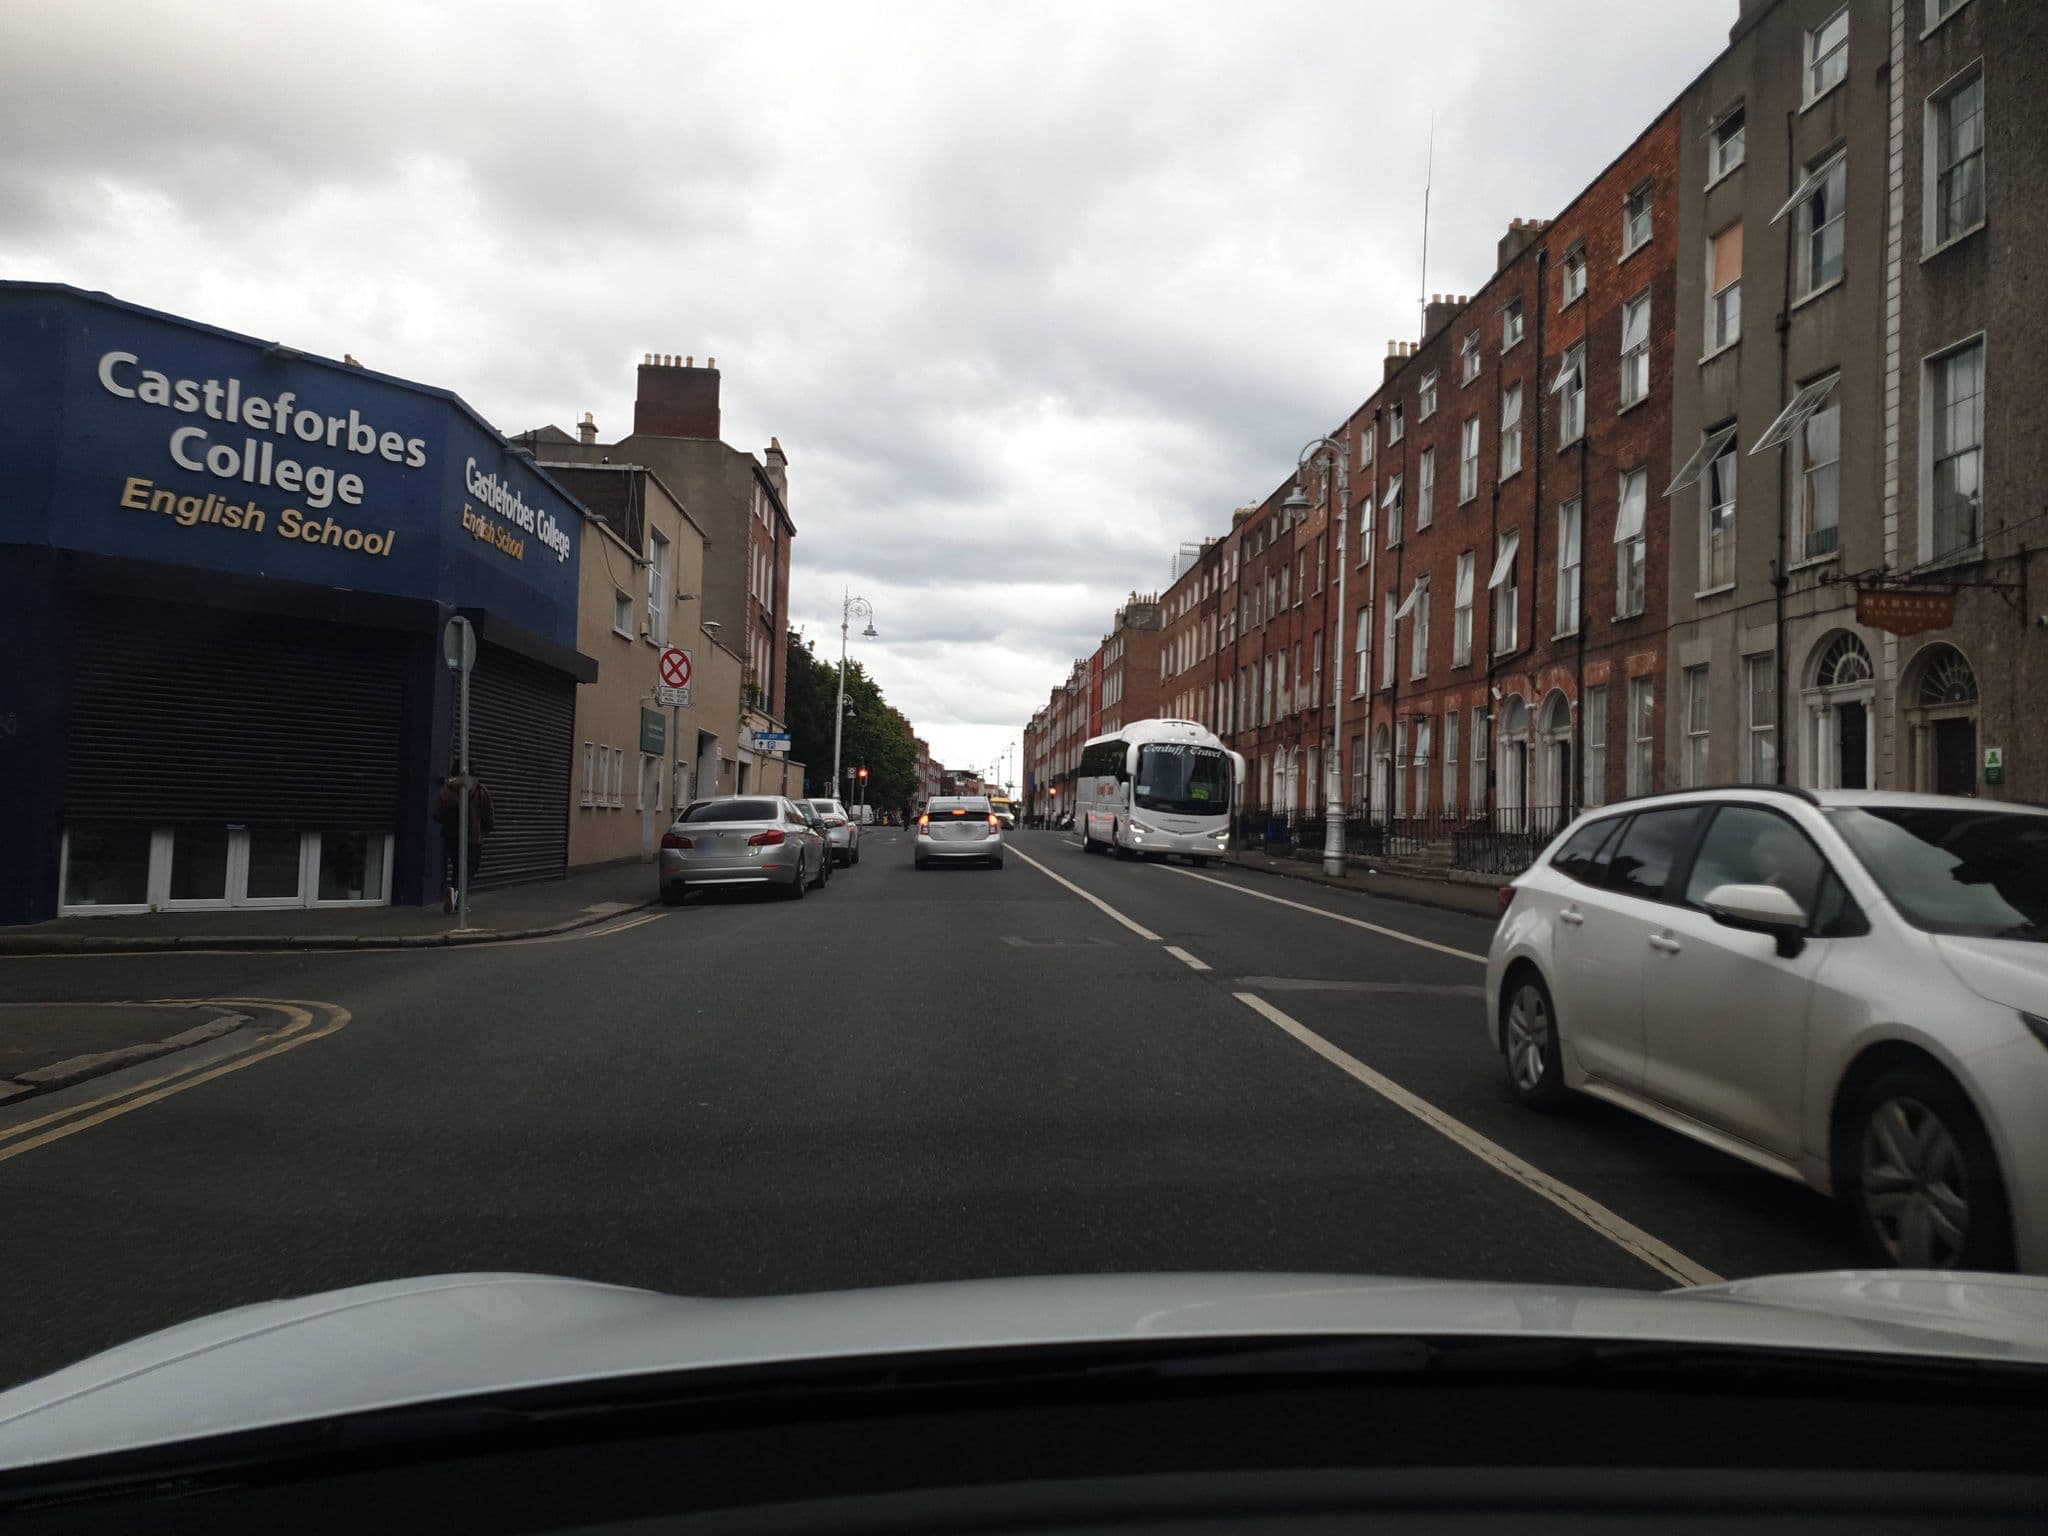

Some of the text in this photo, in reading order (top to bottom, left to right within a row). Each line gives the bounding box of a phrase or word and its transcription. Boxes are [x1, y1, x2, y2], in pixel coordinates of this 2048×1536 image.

[98, 350, 427, 468] Castleforbes
[169, 426, 365, 509] College
[120, 477, 395, 557] English School
[462, 504, 524, 561] English School
[466, 457, 570, 562] Castleforbes College
[1190, 745, 1222, 758] Travel
